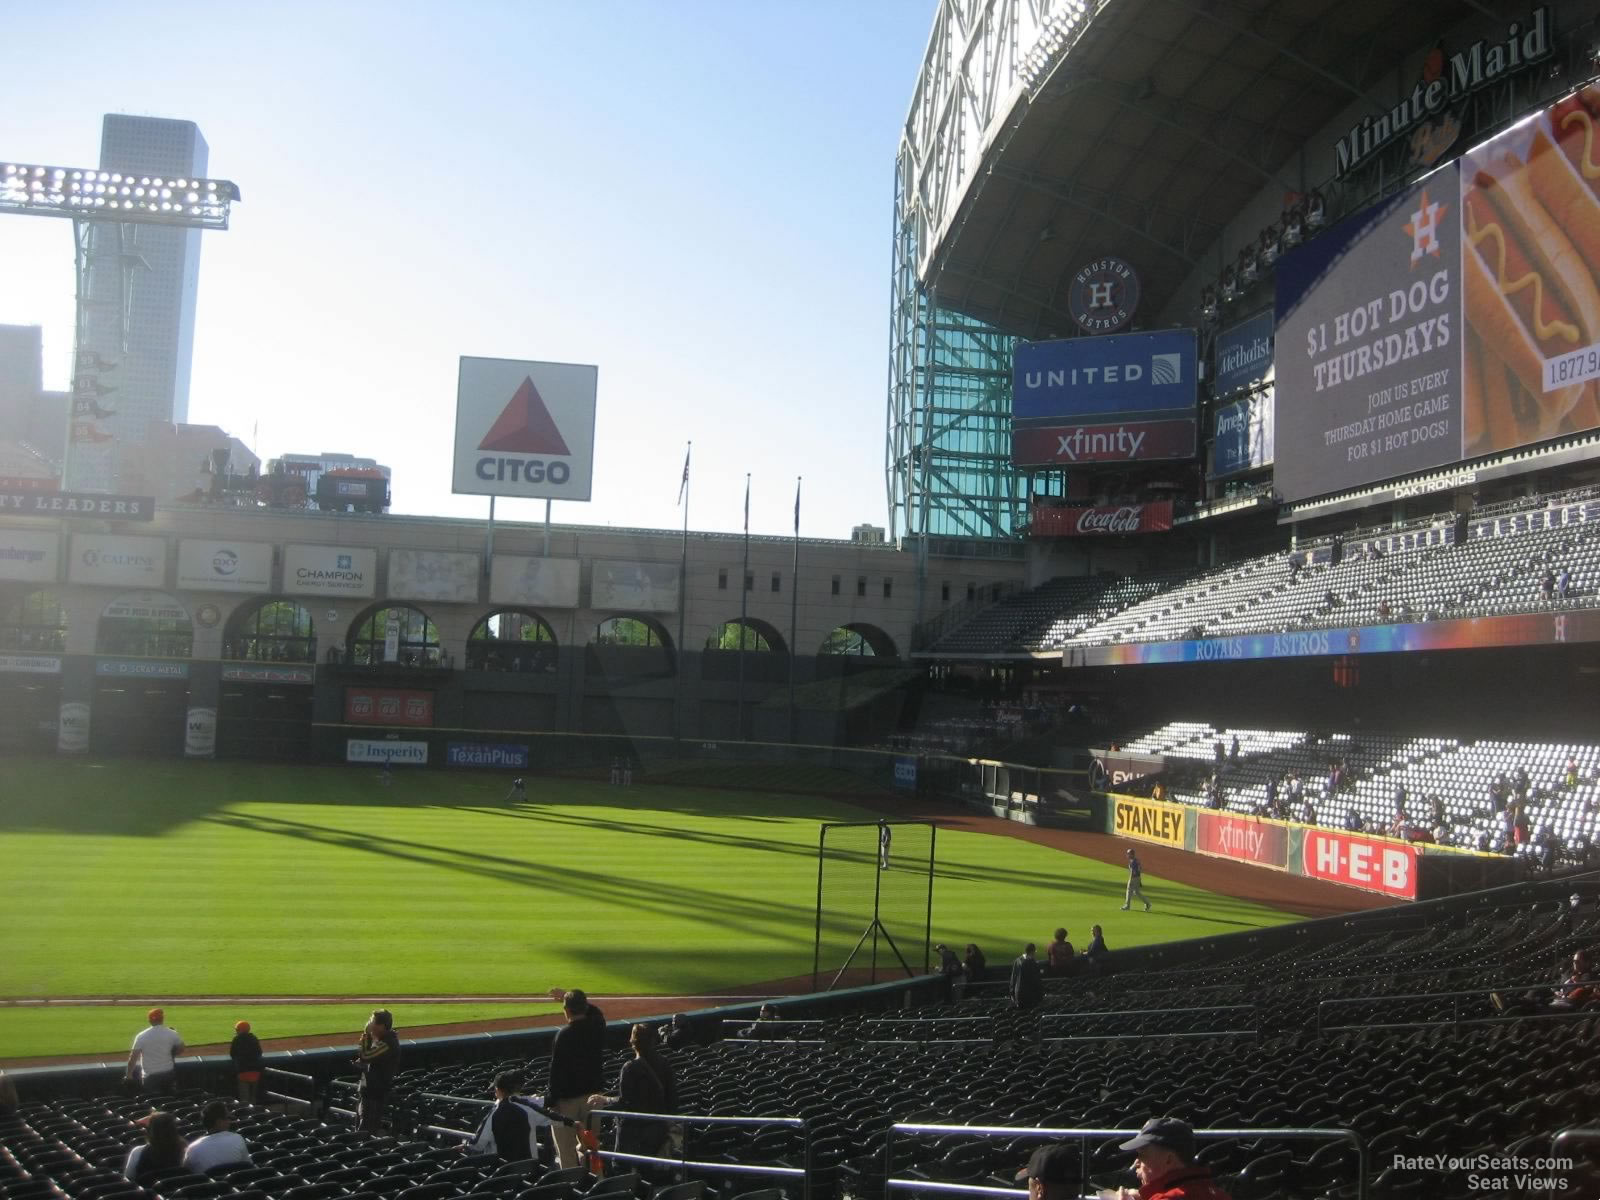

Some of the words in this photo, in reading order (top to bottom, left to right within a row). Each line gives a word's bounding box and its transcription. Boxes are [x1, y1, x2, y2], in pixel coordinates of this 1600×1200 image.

[1334, 79, 1443, 180] Minute
[1450, 7, 1549, 98] Maid
[1411, 202, 1439, 260] H
[1077, 260, 1131, 284] HOUSTON
[1088, 281, 1115, 308] H
[1077, 308, 1129, 329] ASTROS
[1307, 324, 1328, 359] $1
[1334, 298, 1383, 347] HOT
[1389, 269, 1449, 324] DOG
[1218, 336, 1270, 376] Methodist
[1313, 313, 1450, 392] THURSDAYS
[1025, 364, 1143, 389] UNITED
[1551, 350, 1600, 385] 1.877.9
[1368, 388, 1392, 413] JOIN
[1394, 381, 1409, 401] US
[1411, 369, 1449, 397] EVERY
[1324, 411, 1377, 446] THURSDAY
[1378, 405, 1412, 430] HOME
[1414, 394, 1450, 421] GAME
[1057, 426, 1146, 461] xfinity
[1347, 442, 1368, 462] FOR
[1370, 436, 1382, 457] $1
[1385, 430, 1409, 453] HOT
[1411, 420, 1450, 446] DOGS!
[475, 456, 570, 484] CITGO
[1394, 472, 1477, 500] DAKTRONICS
[35, 496, 141, 515] LEADERS
[1077, 505, 1144, 533] Coca-Cola
[1493, 503, 1587, 539] ASTROS
[1362, 528, 1447, 553] HOUSTON
[212, 557, 239, 567] OXY
[296, 567, 363, 581] CHAMPION
[1554, 615, 1566, 642] H
[1195, 639, 1243, 660] ROYALS
[1271, 631, 1329, 656] ASTROS
[366, 743, 425, 761] Insperity
[450, 746, 523, 765] TexanPlus
[1116, 803, 1182, 841] STANLEY
[1218, 819, 1264, 860] xfinity
